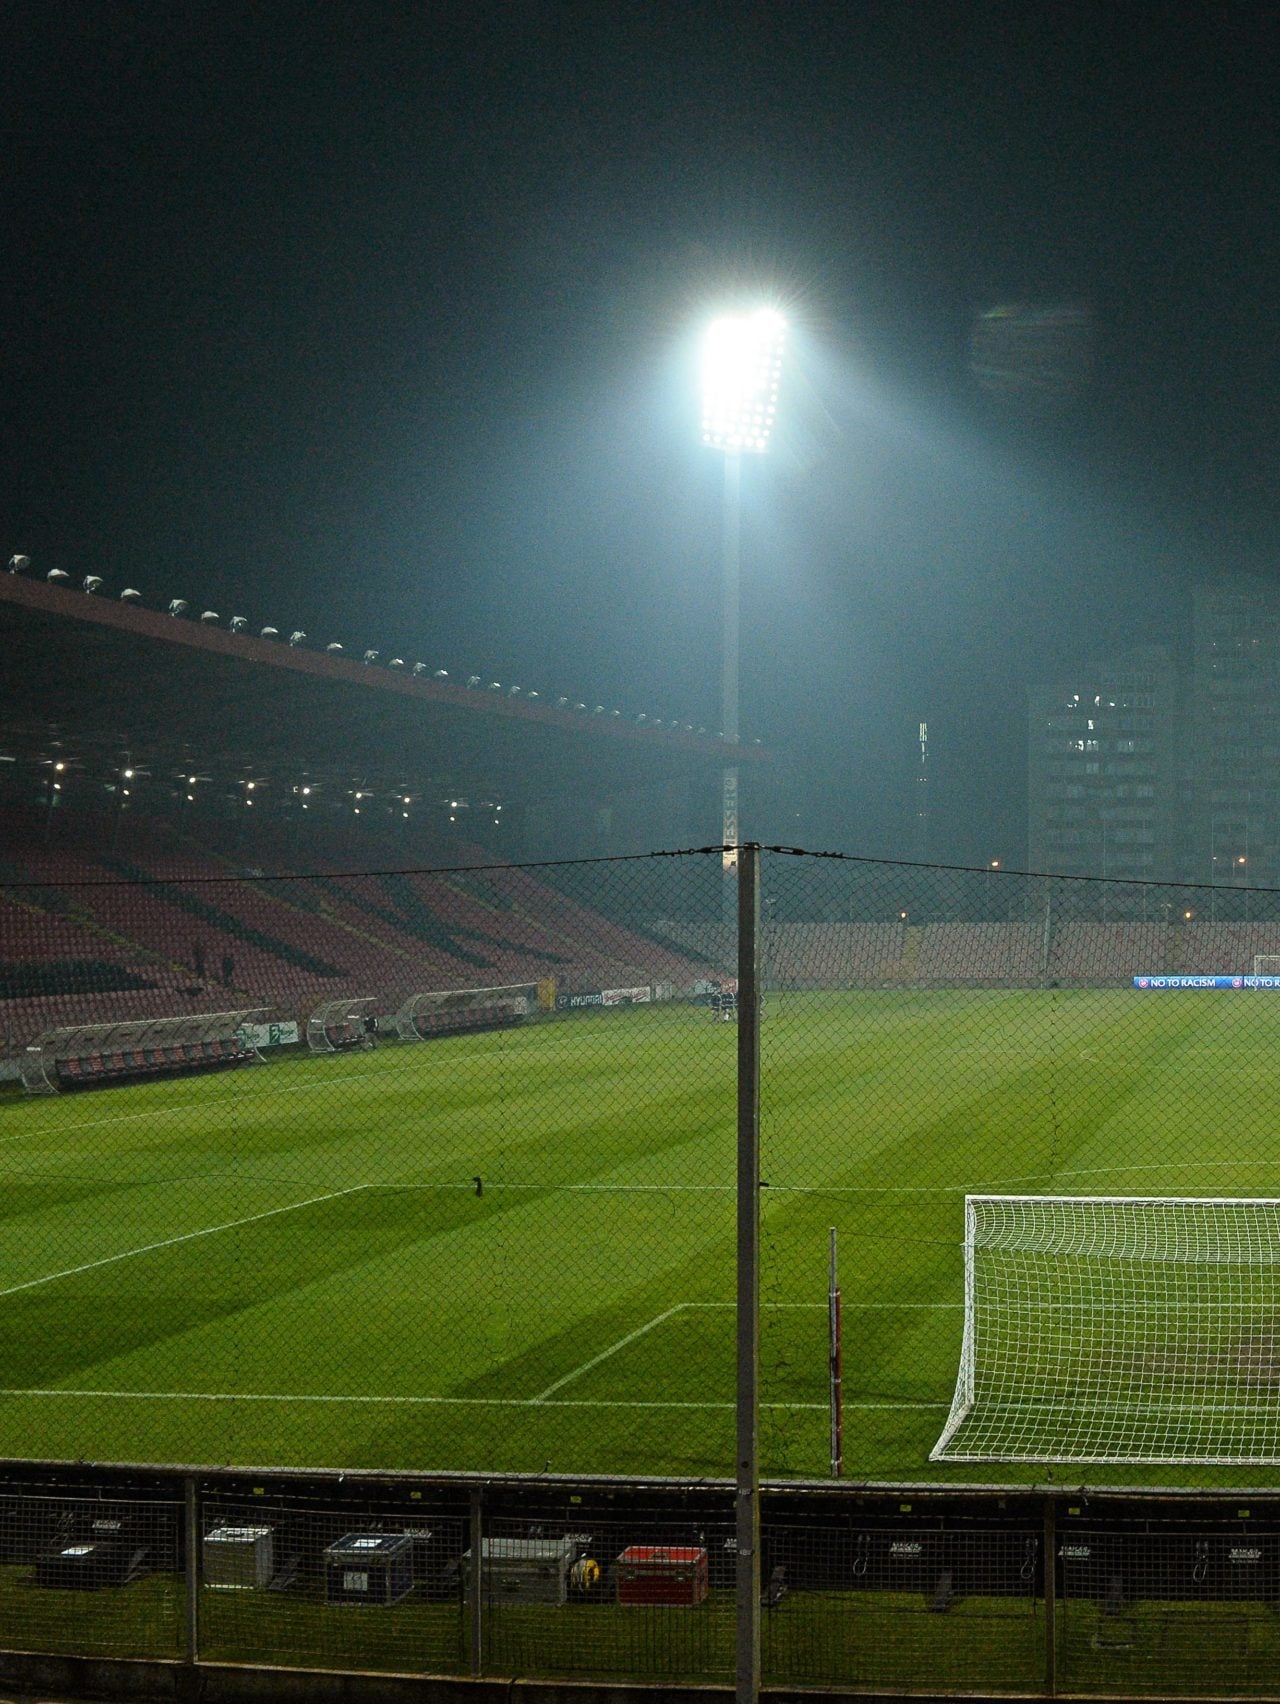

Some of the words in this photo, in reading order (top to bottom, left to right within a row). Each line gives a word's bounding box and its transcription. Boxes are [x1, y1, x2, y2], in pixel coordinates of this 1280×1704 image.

[1150, 979, 1165, 987] NO
[1167, 979, 1179, 987] TO
[1181, 979, 1216, 987] RACISM
[1244, 979, 1258, 987] NO
[1260, 979, 1272, 987] TO
[570, 995, 602, 1006] HYUNDAI
